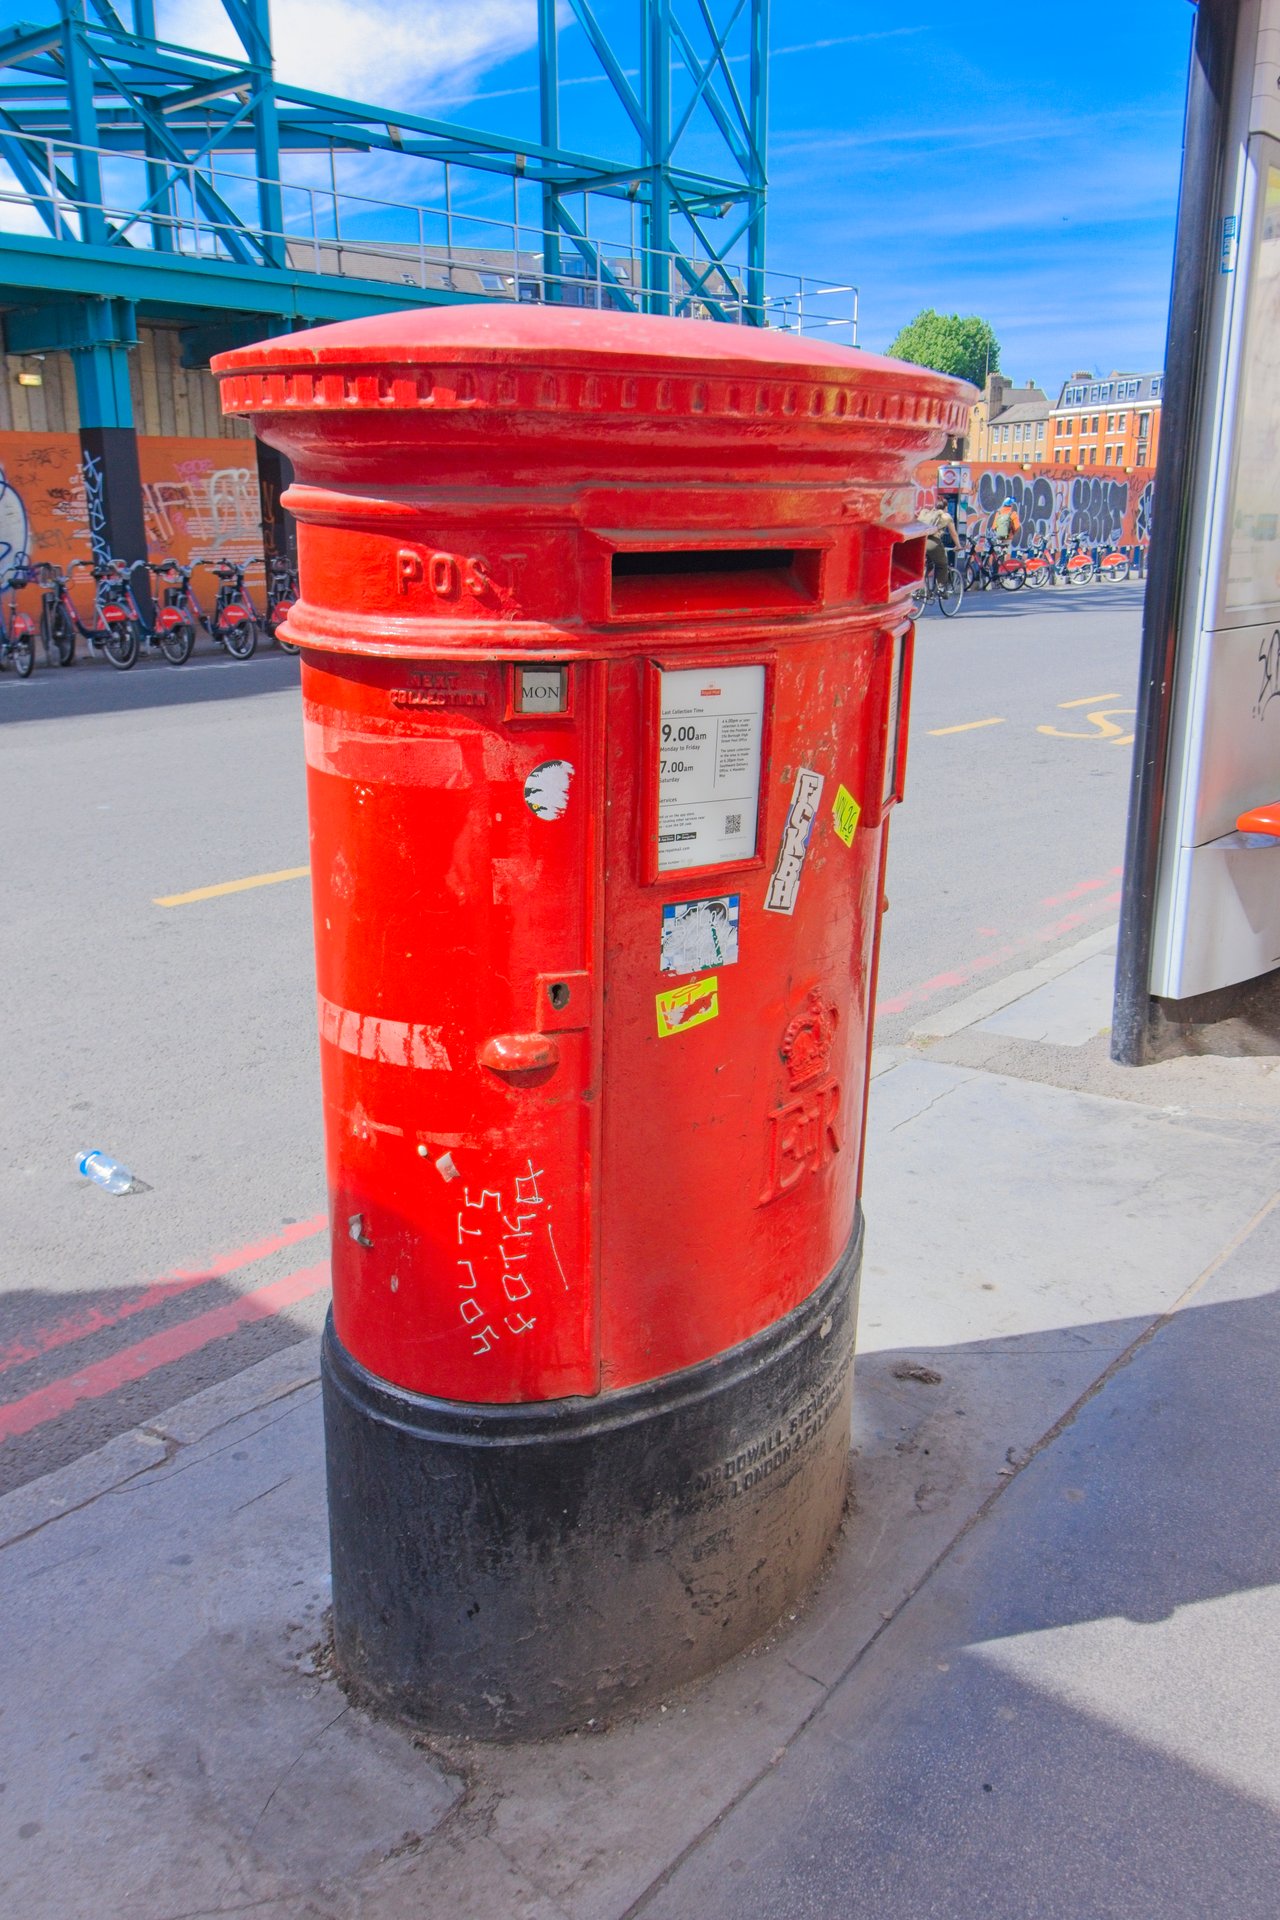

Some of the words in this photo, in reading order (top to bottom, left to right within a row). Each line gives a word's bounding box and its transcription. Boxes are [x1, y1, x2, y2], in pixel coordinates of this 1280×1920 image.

[397, 550, 528, 597] POST
[390, 689, 488, 706] COLLECTION
[521, 686, 560, 699] MON
[662, 724, 707, 743] 9.00am
[660, 760, 694, 774] 7.00am
